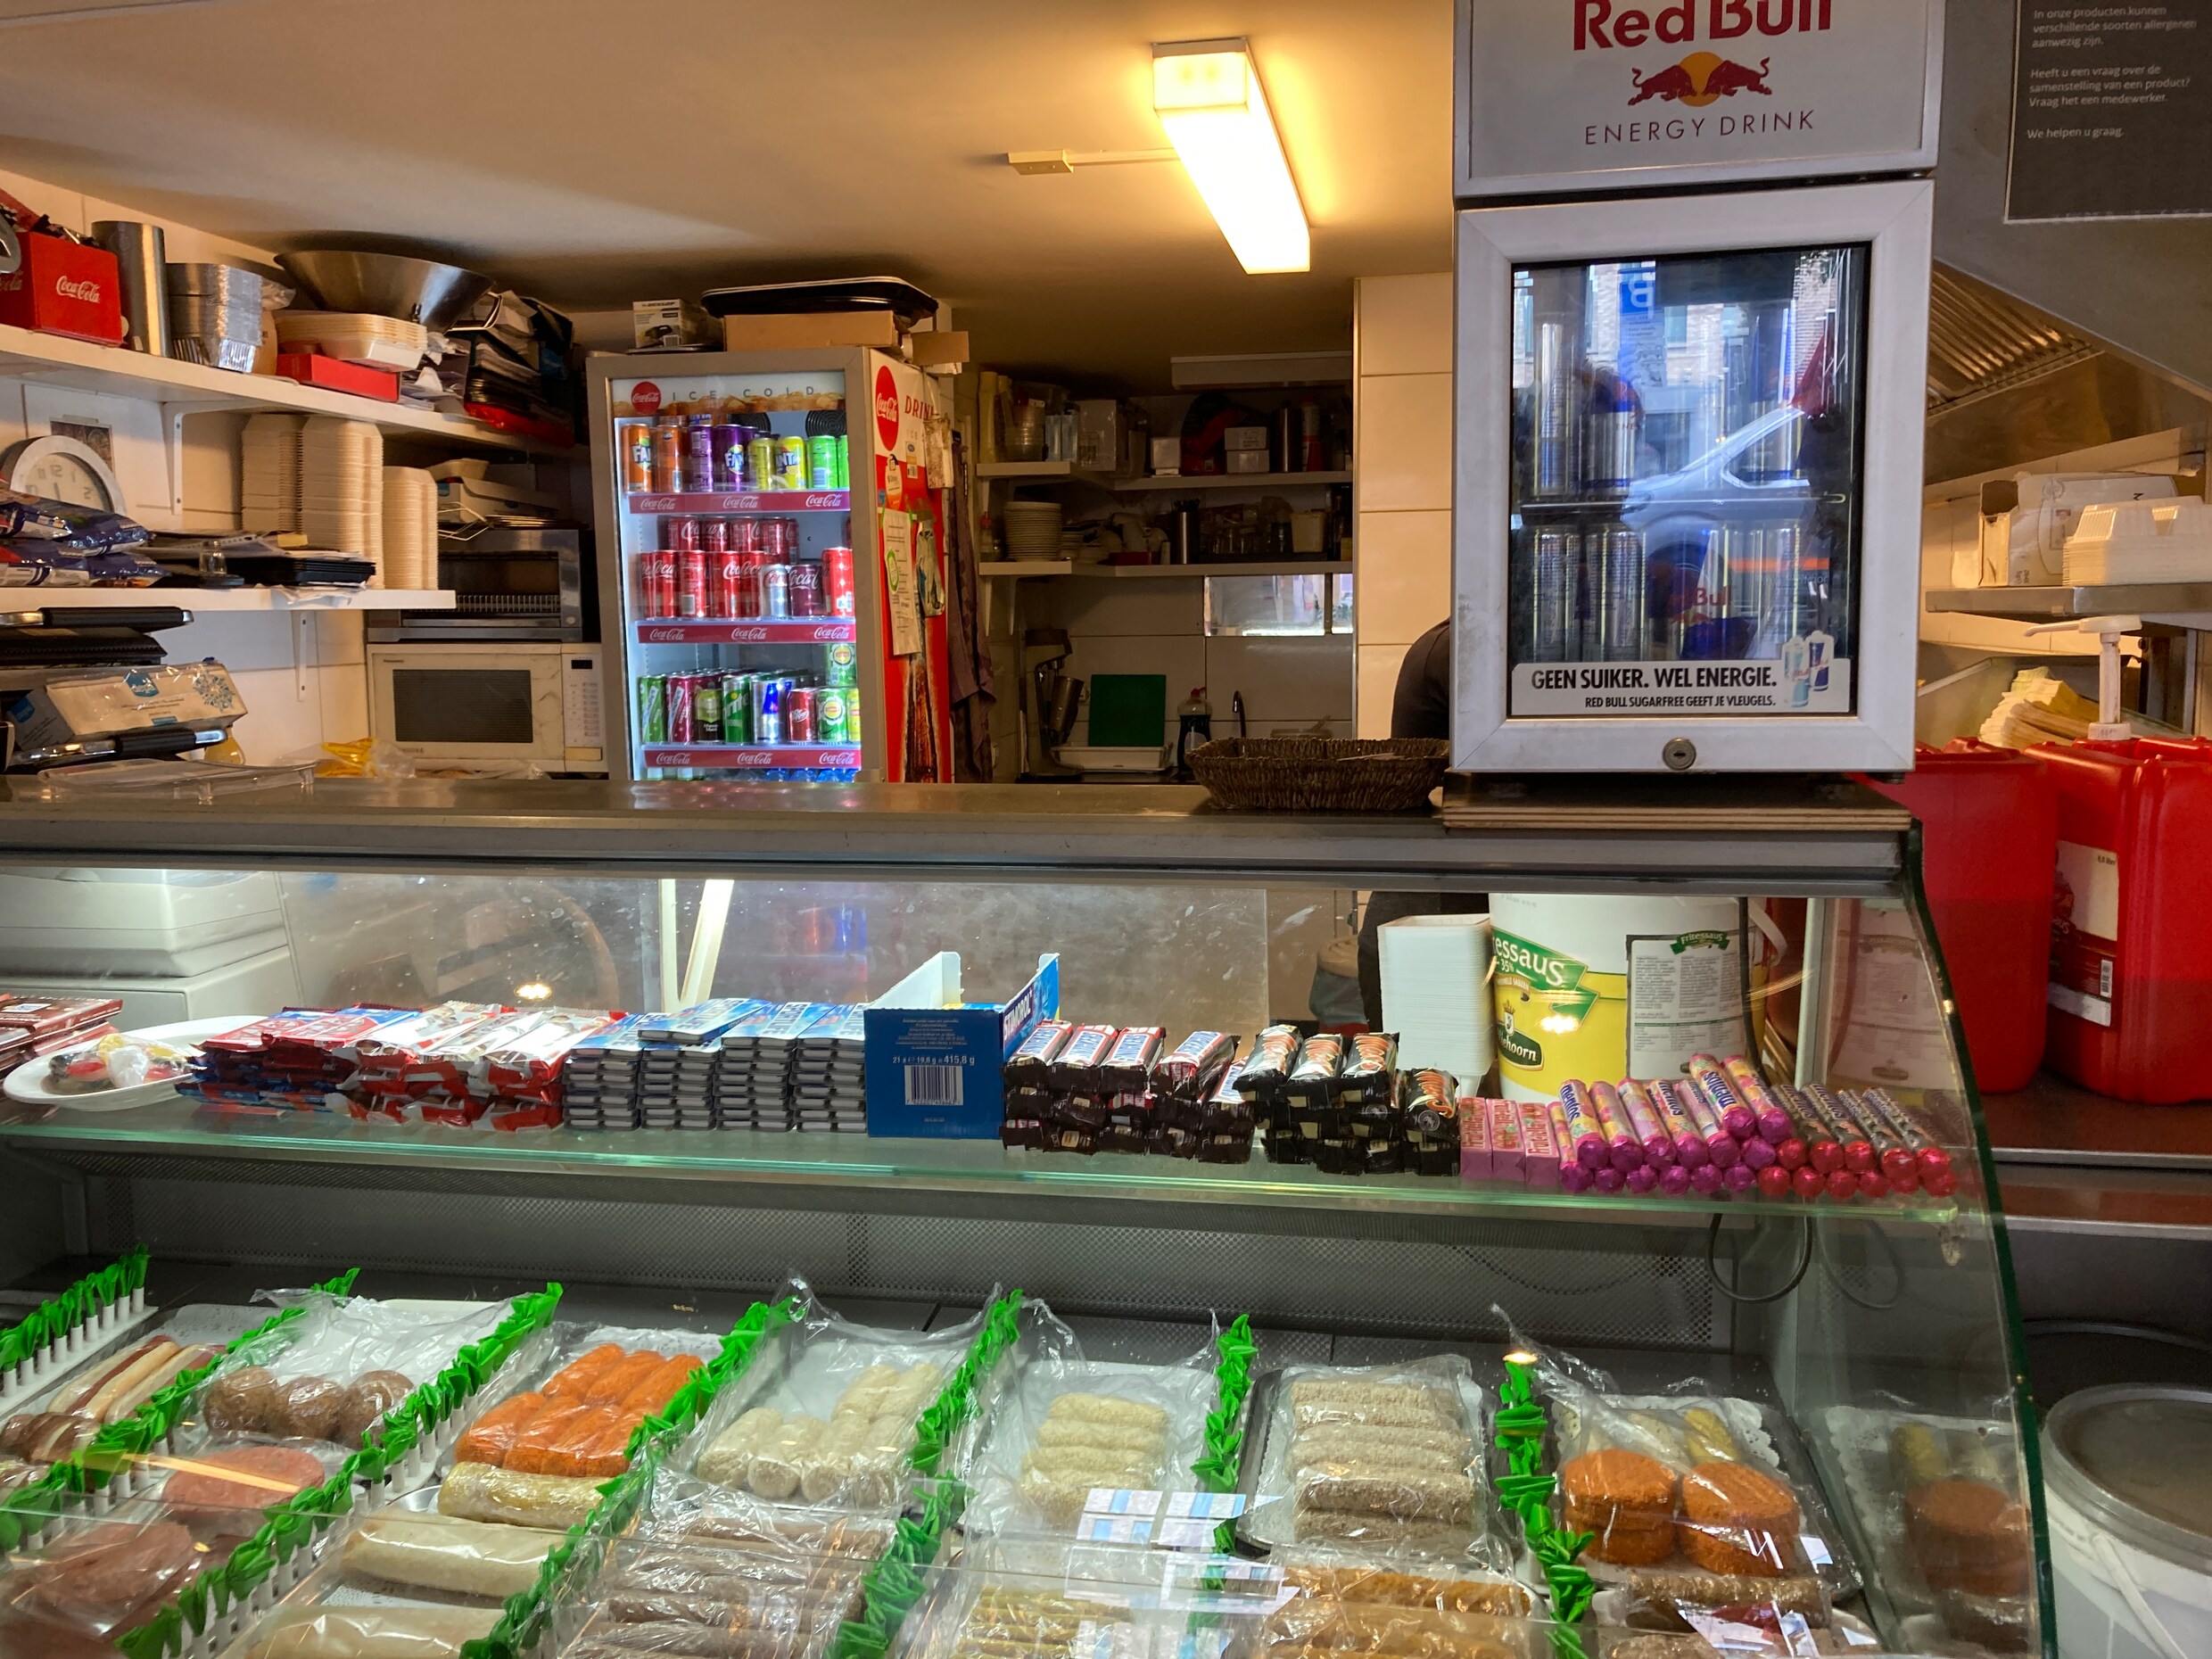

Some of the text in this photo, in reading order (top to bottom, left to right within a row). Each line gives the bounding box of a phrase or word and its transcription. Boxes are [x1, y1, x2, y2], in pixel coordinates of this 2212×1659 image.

[2034, 6, 2167, 20] In onze producten kunnen
[1573, 0, 1832, 50] Red Bull
[2033, 20, 2198, 33] verschillende soorten allergenen
[2032, 37, 2081, 48] aanwezig
[2030, 64, 2161, 78] Heeft u een vraag over de
[2029, 78, 2191, 93] samenstelling van een product?
[2029, 93, 2168, 109] Vraag het een medewerker.
[1585, 110, 1814, 144] ENERGY DRINK
[2026, 129, 2044, 139] We
[2046, 128, 2082, 139] helpen
[2092, 128, 2125, 139] graag.
[673, 386, 814, 400] ICE COLD
[1531, 669, 1576, 689] GEEN
[1581, 668, 1649, 689] SUIKER.
[1655, 667, 1693, 688] WEL
[1696, 666, 1777, 688] ENERGIE.
[1585, 695, 1777, 708] RED BULL SUGARFREE GEEFT JE VLEUGELS.
[1680, 932, 1724, 945] Fritessaus
[1493, 937, 1564, 986] essaus
[1498, 1031, 1537, 1061] ehoorn
[944, 1055, 968, 1065] 415,8
[970, 1057, 975, 1066] g
[1702, 1071, 1737, 1109] mentos
[1560, 1084, 1581, 1124] mentos
